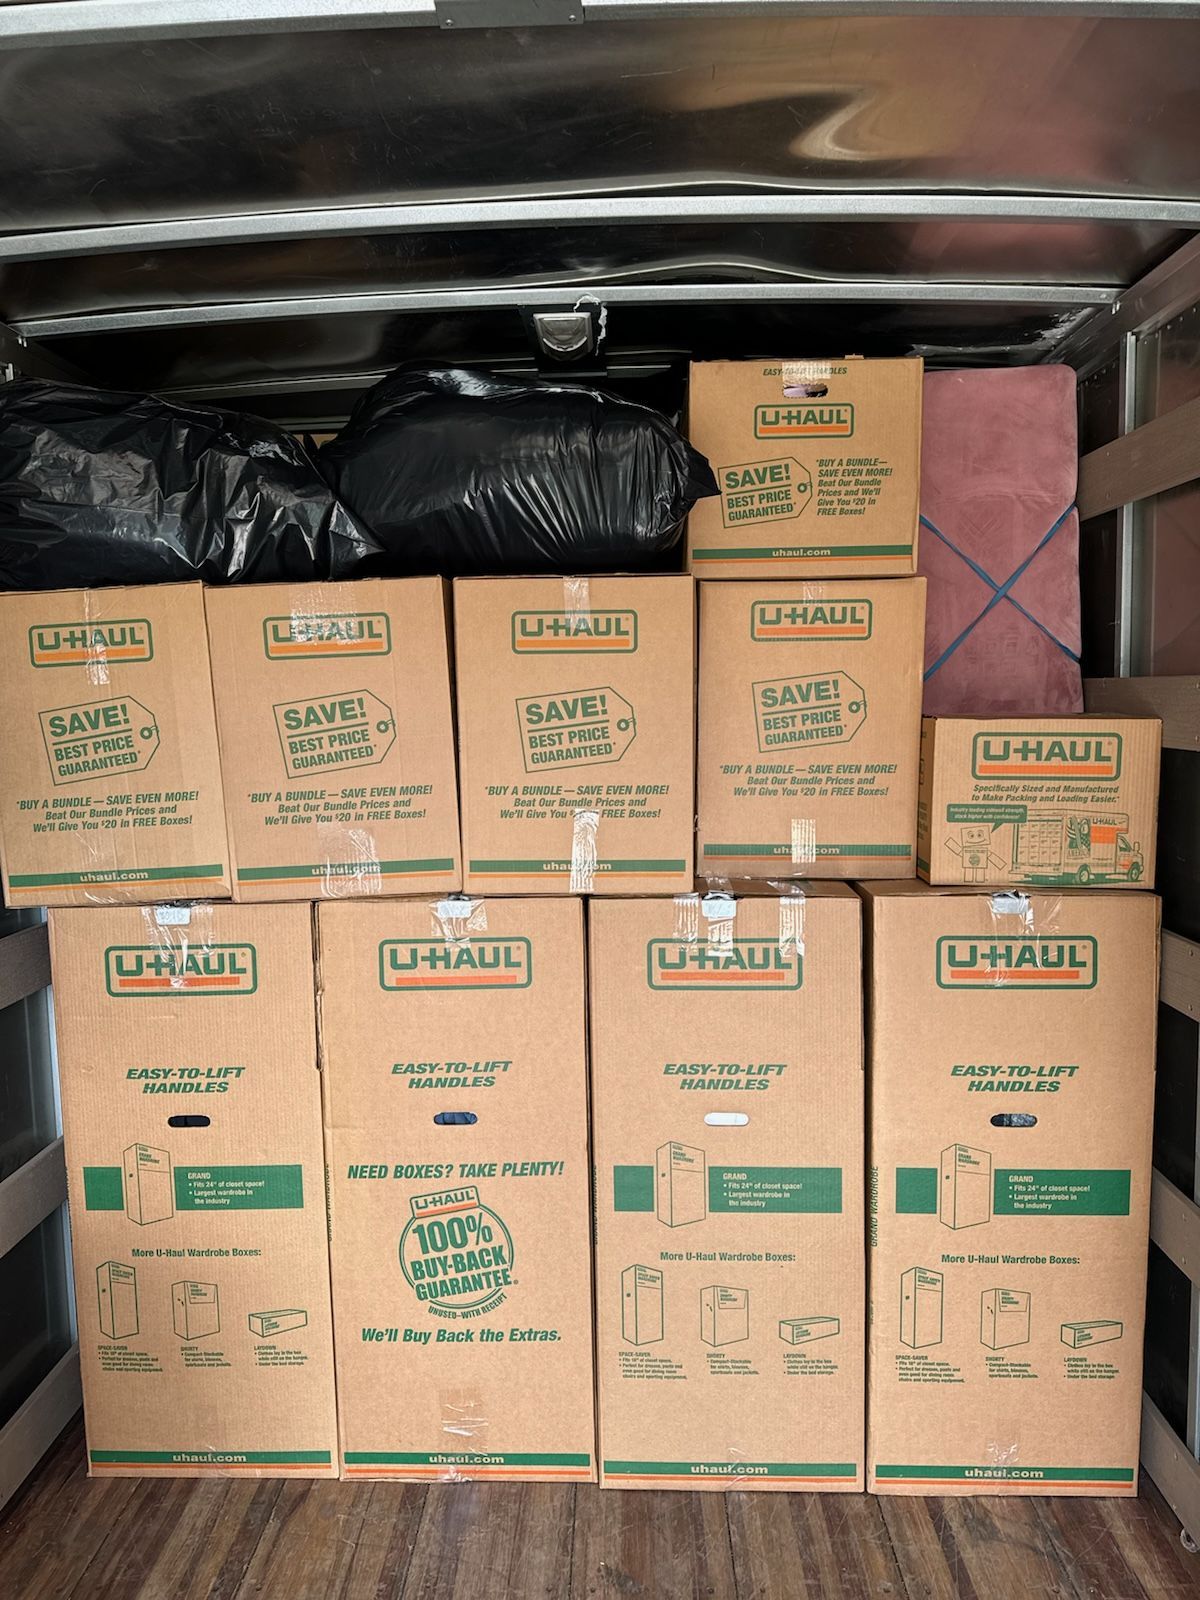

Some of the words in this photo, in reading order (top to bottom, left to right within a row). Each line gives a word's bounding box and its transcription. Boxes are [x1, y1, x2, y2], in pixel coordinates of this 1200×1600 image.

[761, 410, 847, 425] U-HAUL
[834, 459, 843, 467] A
[725, 464, 791, 490] SAVE!
[818, 469, 839, 477] SAVE
[841, 469, 863, 477] EVEN
[865, 468, 892, 476] MORE!
[727, 495, 758, 510] BEST
[759, 490, 792, 505] PRICE
[772, 548, 831, 557] uhaul.com
[760, 606, 864, 625] U-HAUL
[272, 619, 383, 644] U-HAUL
[520, 617, 629, 637] U-HAUL
[37, 624, 144, 651] U-HAUL
[760, 679, 841, 710] SAVE!
[284, 697, 367, 731] SAVE!
[525, 694, 609, 726] SAVE!
[49, 703, 131, 738] SAVE!
[762, 714, 799, 733] BEST
[801, 709, 842, 727] PRICE
[288, 733, 324, 755] BEST
[327, 729, 371, 748] PRICE
[529, 730, 564, 750] BEST
[568, 726, 611, 745] PRICE
[54, 739, 89, 762] BEST
[91, 735, 135, 755] PRICE
[983, 740, 1112, 762] U-HAUL
[745, 765, 752, 774] A
[836, 764, 862, 774] EVEN
[865, 764, 897, 773] MORE!
[747, 776, 769, 785] Beat
[771, 776, 788, 785] Our
[790, 776, 823, 785] Bundle
[825, 776, 854, 785] Prices
[857, 776, 875, 785] and
[274, 792, 282, 802] A
[370, 787, 396, 797] EVEN
[400, 785, 432, 795] MORE!
[511, 786, 518, 795] A
[606, 785, 633, 795] EVEN
[635, 785, 669, 795] MORE!
[759, 787, 778, 796] Give
[782, 787, 798, 796] You
[801, 787, 816, 796] $20
[819, 787, 828, 796] in
[831, 787, 855, 796] FREE
[857, 787, 889, 796] Boxes!
[973, 784, 1020, 793] Specifically
[1063, 785, 1119, 793] Manufactured
[42, 799, 49, 809] A
[135, 793, 161, 803] EVEN
[165, 791, 199, 802] MORE!
[278, 804, 300, 813] Beat
[303, 803, 320, 812] Our
[324, 801, 357, 811] Bundle
[360, 800, 390, 809] Prices
[393, 798, 411, 807] and
[1006, 794, 1037, 803] Packing
[1057, 795, 1088, 804] Loading
[45, 811, 66, 820] Beat
[70, 810, 87, 819] Our
[90, 808, 123, 818] Bundle
[126, 806, 157, 818] Prices
[159, 804, 177, 814] and
[80, 870, 148, 882] uhaul.com
[390, 946, 521, 970] U-HAUL
[658, 947, 792, 970] U-HAUL
[948, 945, 1087, 968] U-HAUL
[115, 953, 246, 976] U-HAUL
[126, 1067, 245, 1079] EASY-TO-LIFT
[392, 1061, 512, 1074] EASY-TO-LIFT
[663, 1064, 787, 1075] EASY-TO-LIFT
[951, 1065, 1079, 1077] EASY-TO-LIFT
[143, 1082, 229, 1094] HANDLES
[408, 1076, 496, 1088] HANDLES
[680, 1079, 769, 1090] HANDLES
[968, 1081, 1060, 1092] HANDLES
[187, 1172, 211, 1180] GRAND
[348, 1165, 388, 1179] NEED
[393, 1164, 453, 1179] BOXES?
[459, 1163, 497, 1178] TAKE
[502, 1161, 564, 1176] PLENTY!
[722, 1172, 747, 1181] GRAND
[1008, 1175, 1034, 1183] GRAND
[1069, 1185, 1091, 1193] space!
[414, 1190, 474, 1210] U-HAUL
[1013, 1193, 1038, 1201] Largest
[1038, 1193, 1067, 1201] wardrobe
[1025, 1202, 1053, 1211] industry
[412, 1212, 493, 1255] 100%
[410, 1245, 508, 1281] BUY-BACK
[660, 1252, 683, 1260] More
[686, 1252, 716, 1261] U-Haul
[719, 1252, 763, 1261] Wardrobe
[765, 1253, 795, 1261] Boxes:
[942, 1254, 965, 1263] More
[968, 1255, 999, 1263] U-Haul
[1002, 1255, 1046, 1264] Wardrobe
[1050, 1256, 1080, 1264] Boxes:
[481, 1292, 508, 1316] RECEIPT
[362, 1328, 398, 1342] We'll
[403, 1329, 432, 1345] Buy
[436, 1329, 474, 1342] Back
[480, 1329, 504, 1342] the
[509, 1328, 561, 1341] Extras.
[173, 1453, 247, 1463] uhaul.com
[429, 1454, 505, 1464] uhaul.com
[690, 1464, 768, 1475] uhaul.com
[965, 1468, 1044, 1479] uhaul.com
